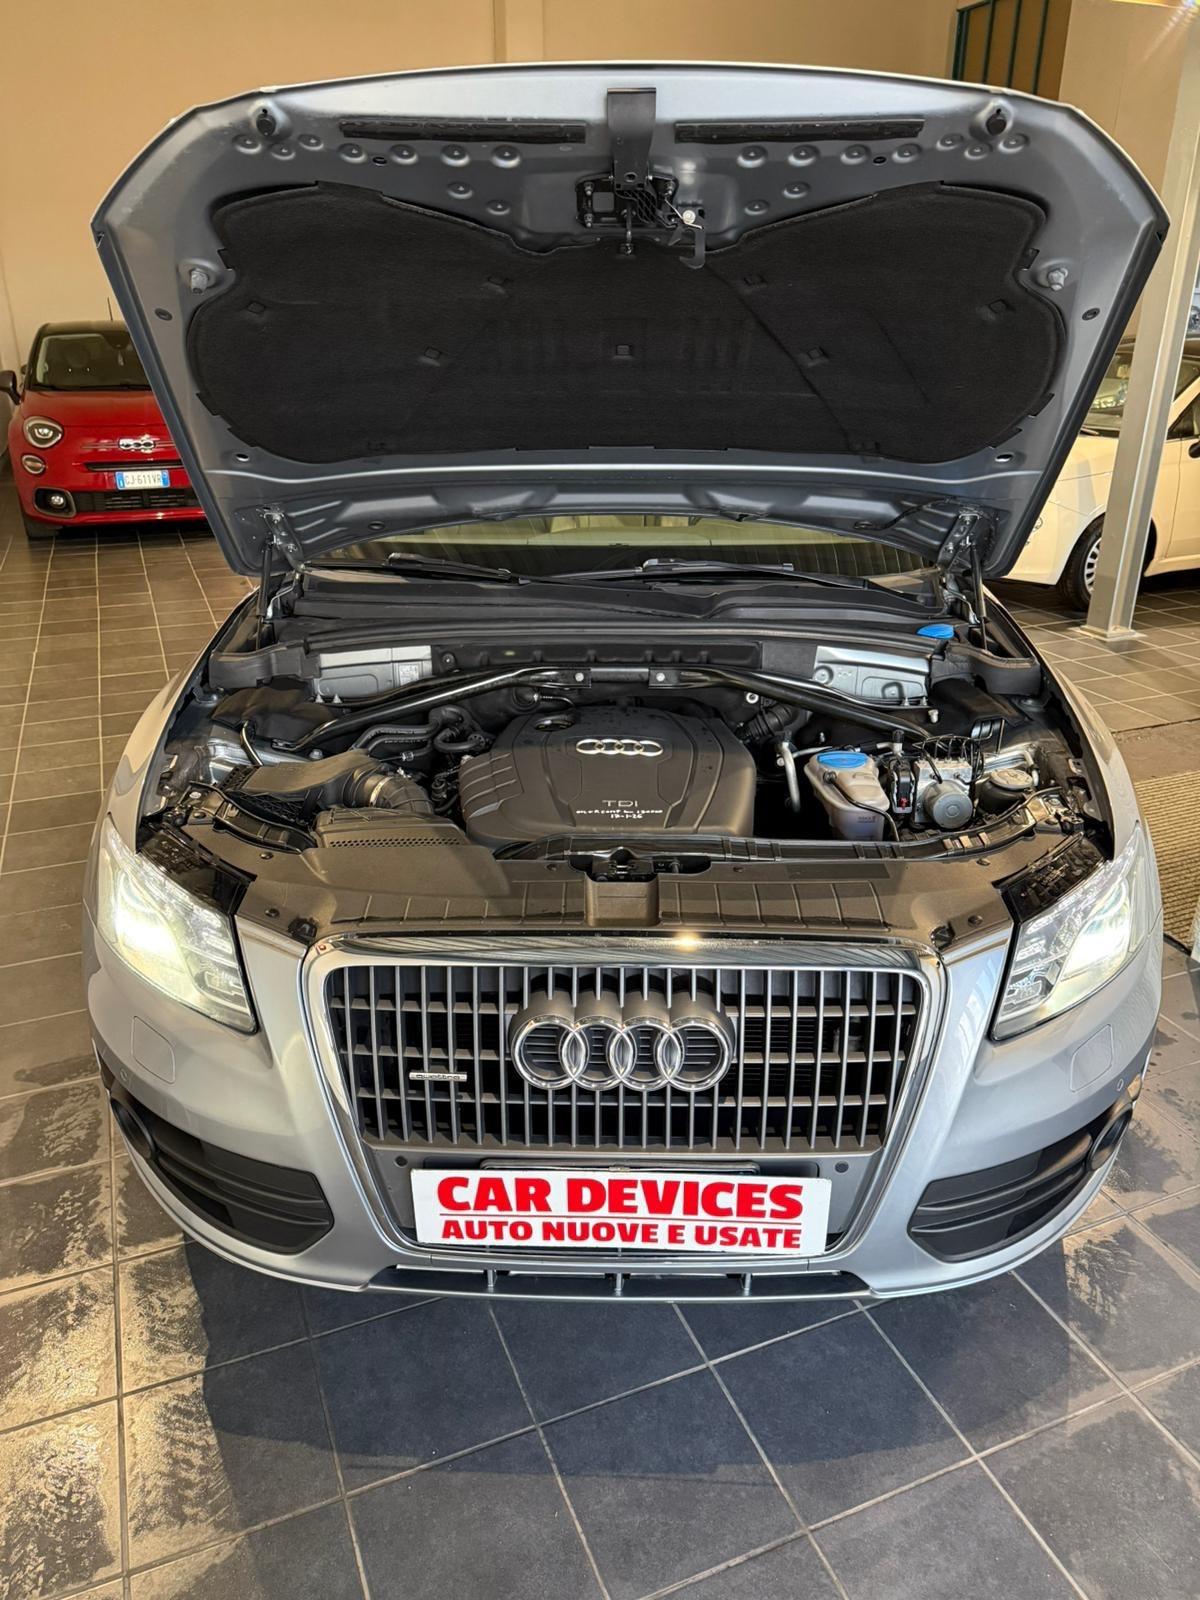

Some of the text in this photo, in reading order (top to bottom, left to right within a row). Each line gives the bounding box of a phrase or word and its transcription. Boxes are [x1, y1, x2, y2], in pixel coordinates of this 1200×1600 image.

[437, 1176, 803, 1220] CAR DEVICES
[442, 1220, 802, 1249] AUTO NUOVE E USATE
